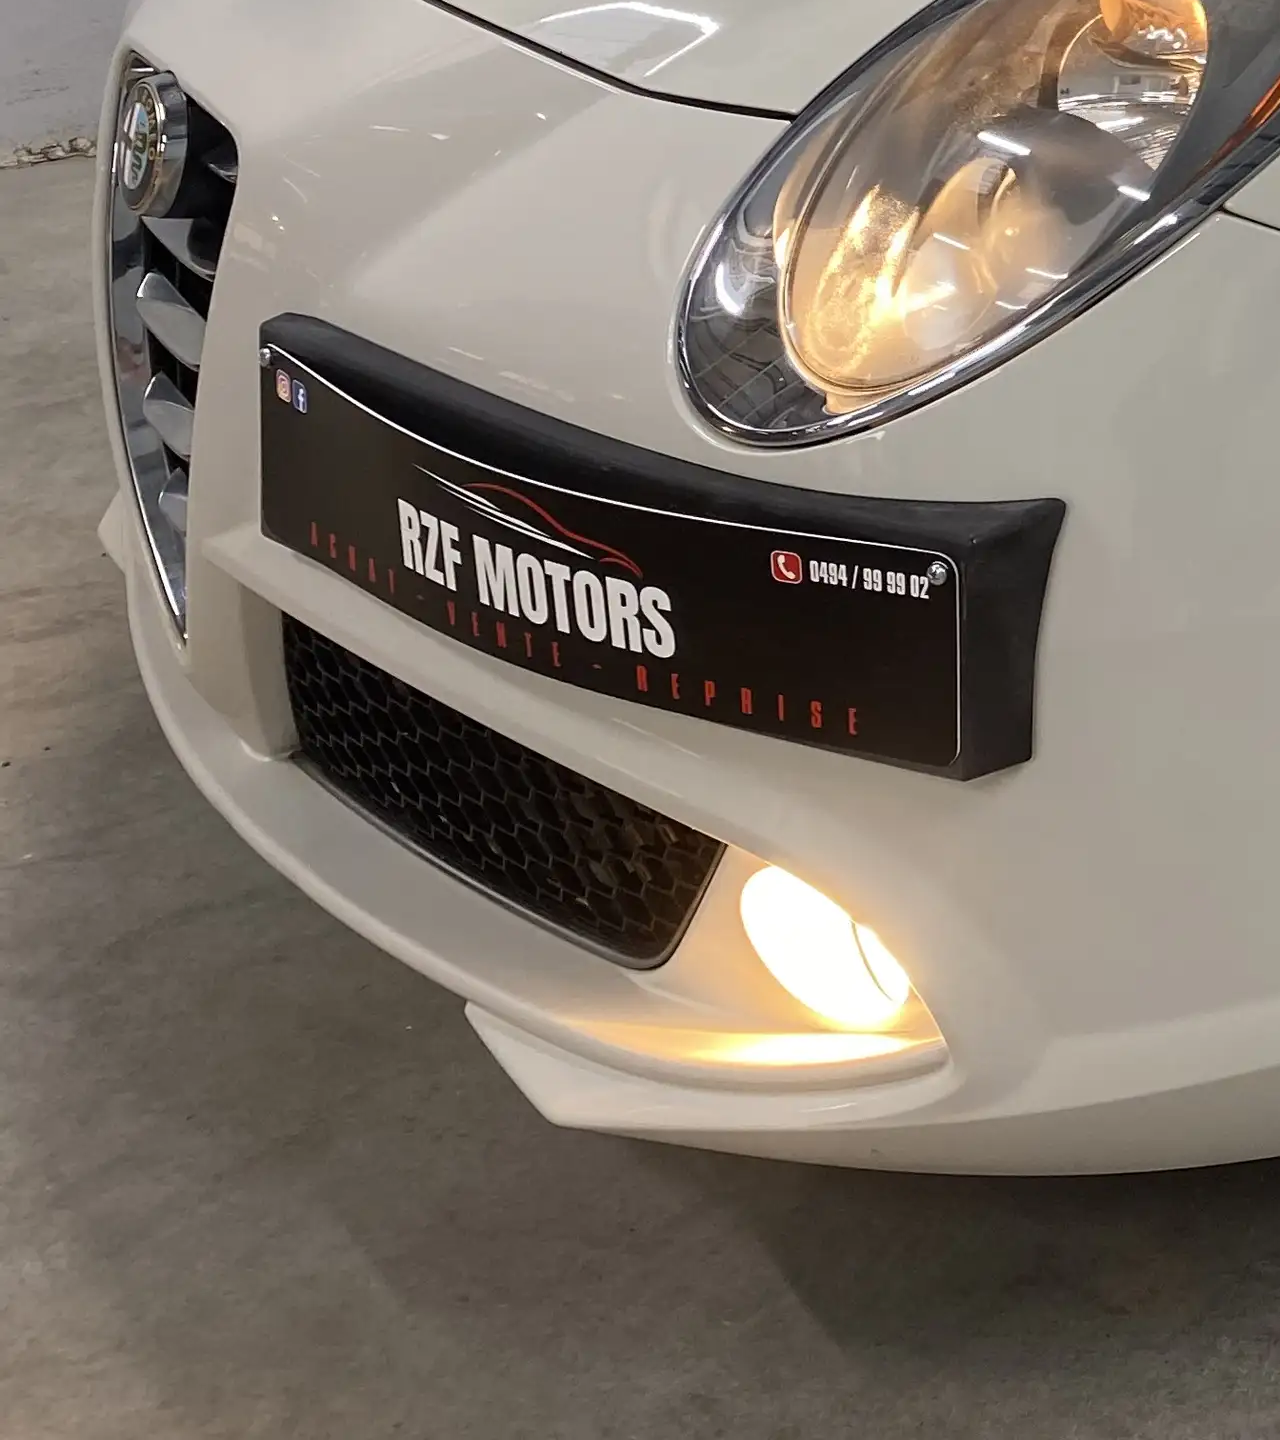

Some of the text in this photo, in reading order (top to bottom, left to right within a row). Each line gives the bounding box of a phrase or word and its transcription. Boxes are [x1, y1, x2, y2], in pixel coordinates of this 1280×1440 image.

[397, 497, 677, 659] RZF MOTORS
[809, 560, 848, 587] 0494
[862, 567, 883, 593] 99
[886, 571, 906, 596] 99
[909, 574, 930, 600] 02
[636, 664, 858, 736] REPRISE
